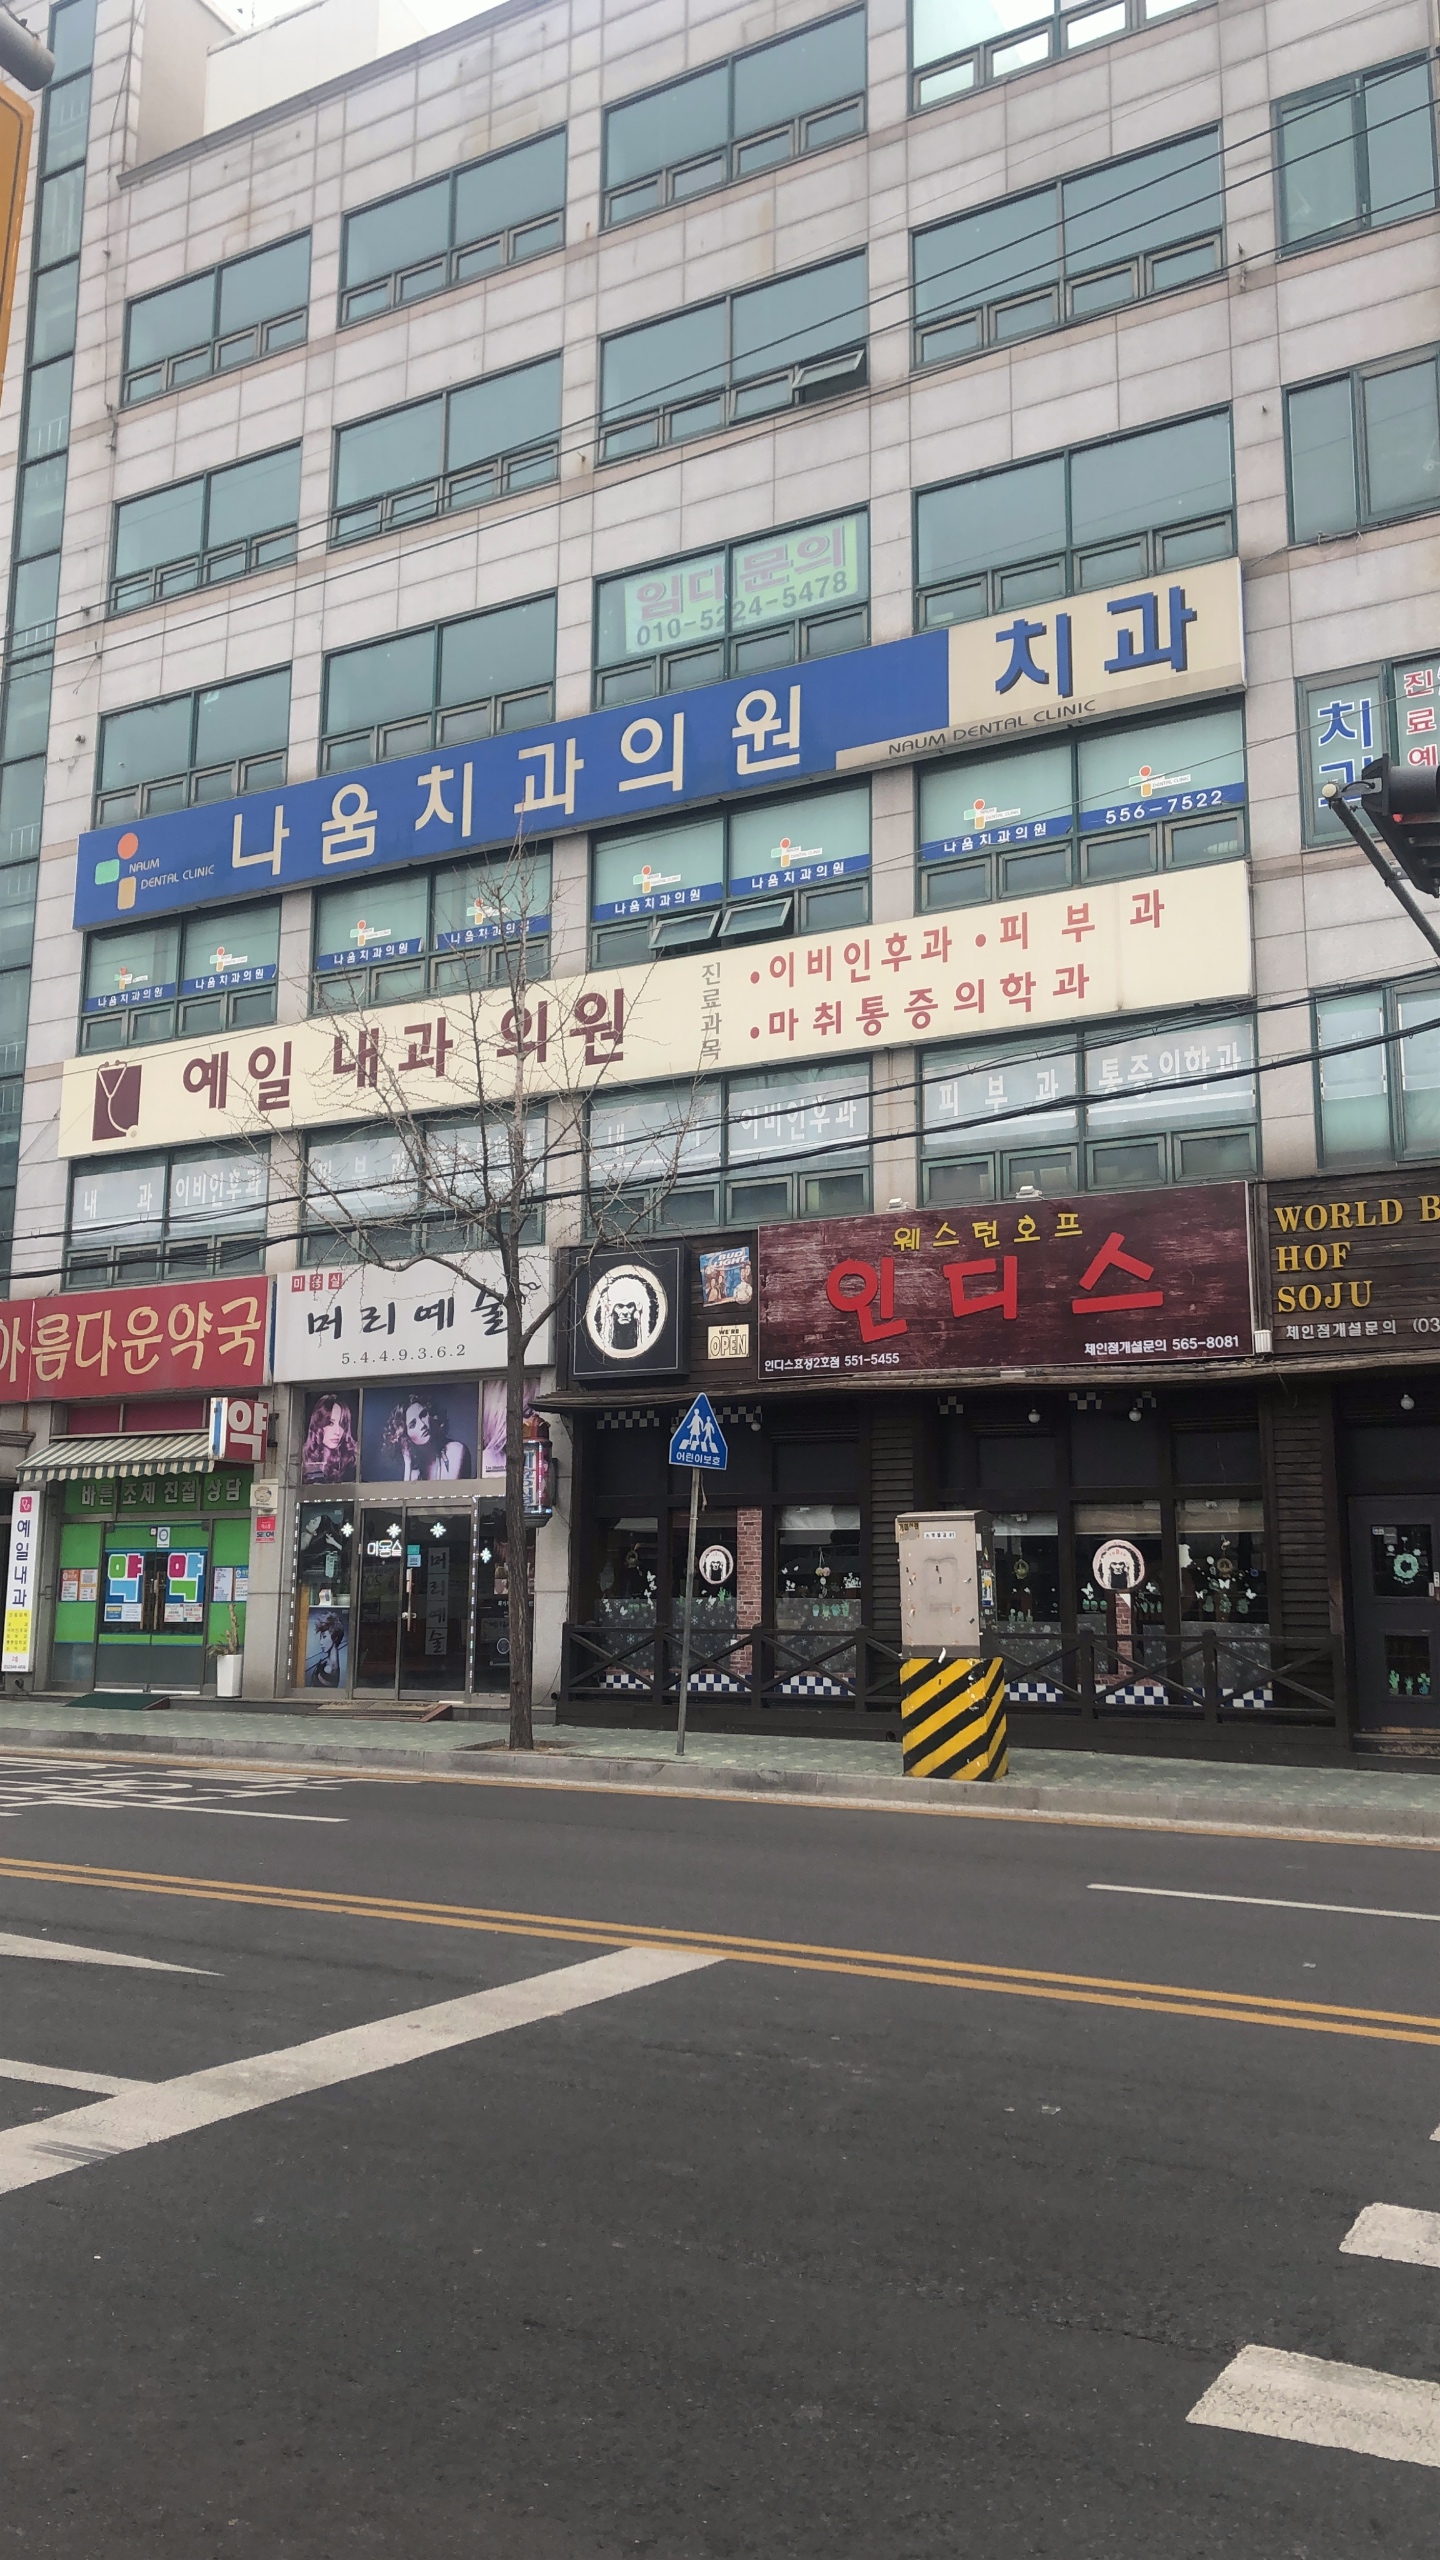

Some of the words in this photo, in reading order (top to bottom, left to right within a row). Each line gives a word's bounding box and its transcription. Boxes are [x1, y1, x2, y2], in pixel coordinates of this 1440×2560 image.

[636, 571, 848, 645] 010-5224-5478
[994, 586, 1198, 698] 치과
[888, 733, 947, 756] NAUM
[953, 716, 1028, 743] DENTAL
[1033, 700, 1096, 723] CLINIC
[231, 684, 802, 875] 나움치과의원
[1105, 790, 1223, 825] 556-7522
[943, 822, 1047, 853] 나움치과의원
[128, 857, 160, 873] NAUM
[140, 871, 179, 890] DENTAL
[182, 864, 215, 880] CLINIC
[751, 861, 845, 889] 나움치과의원
[614, 888, 701, 915] 나움치과의원
[333, 942, 408, 965] 나움치과의원
[769, 925, 953, 988] 이비인후과
[194, 967, 264, 990] 나움치과의원
[97, 986, 164, 1008] 나움치과의원
[700, 961, 722, 1060] 진료과목
[768, 963, 1091, 1042] 마취통증의학과
[175, 1167, 263, 1208] 이비인후과
[1274, 1198, 1404, 1233] WORLD
[712, 1255, 750, 1267] LIGHT
[718, 1250, 744, 1261] BUD
[1276, 1241, 1350, 1272] HOF
[293, 1273, 342, 1291] 미용실
[825, 1230, 1164, 1344] 인디스
[1277, 1280, 1373, 1313] SOJU
[0, 1296, 262, 1383] 아름다운약국
[1286, 1319, 1397, 1340] 체인점개설문의
[709, 1335, 747, 1356] OPEN
[844, 1352, 900, 1367] 551-5455
[1084, 1338, 1167, 1356] 체인점개설문의
[1172, 1335, 1239, 1350] 565-8081
[227, 1400, 269, 1462] 약
[676, 1452, 720, 1466] 어린이보호
[81, 1483, 114, 1507] 바른
[122, 1481, 156, 1505] 조제
[164, 1480, 196, 1504] 친절
[206, 1478, 242, 1502] 상담
[12, 1518, 31, 1608] 예일내과
